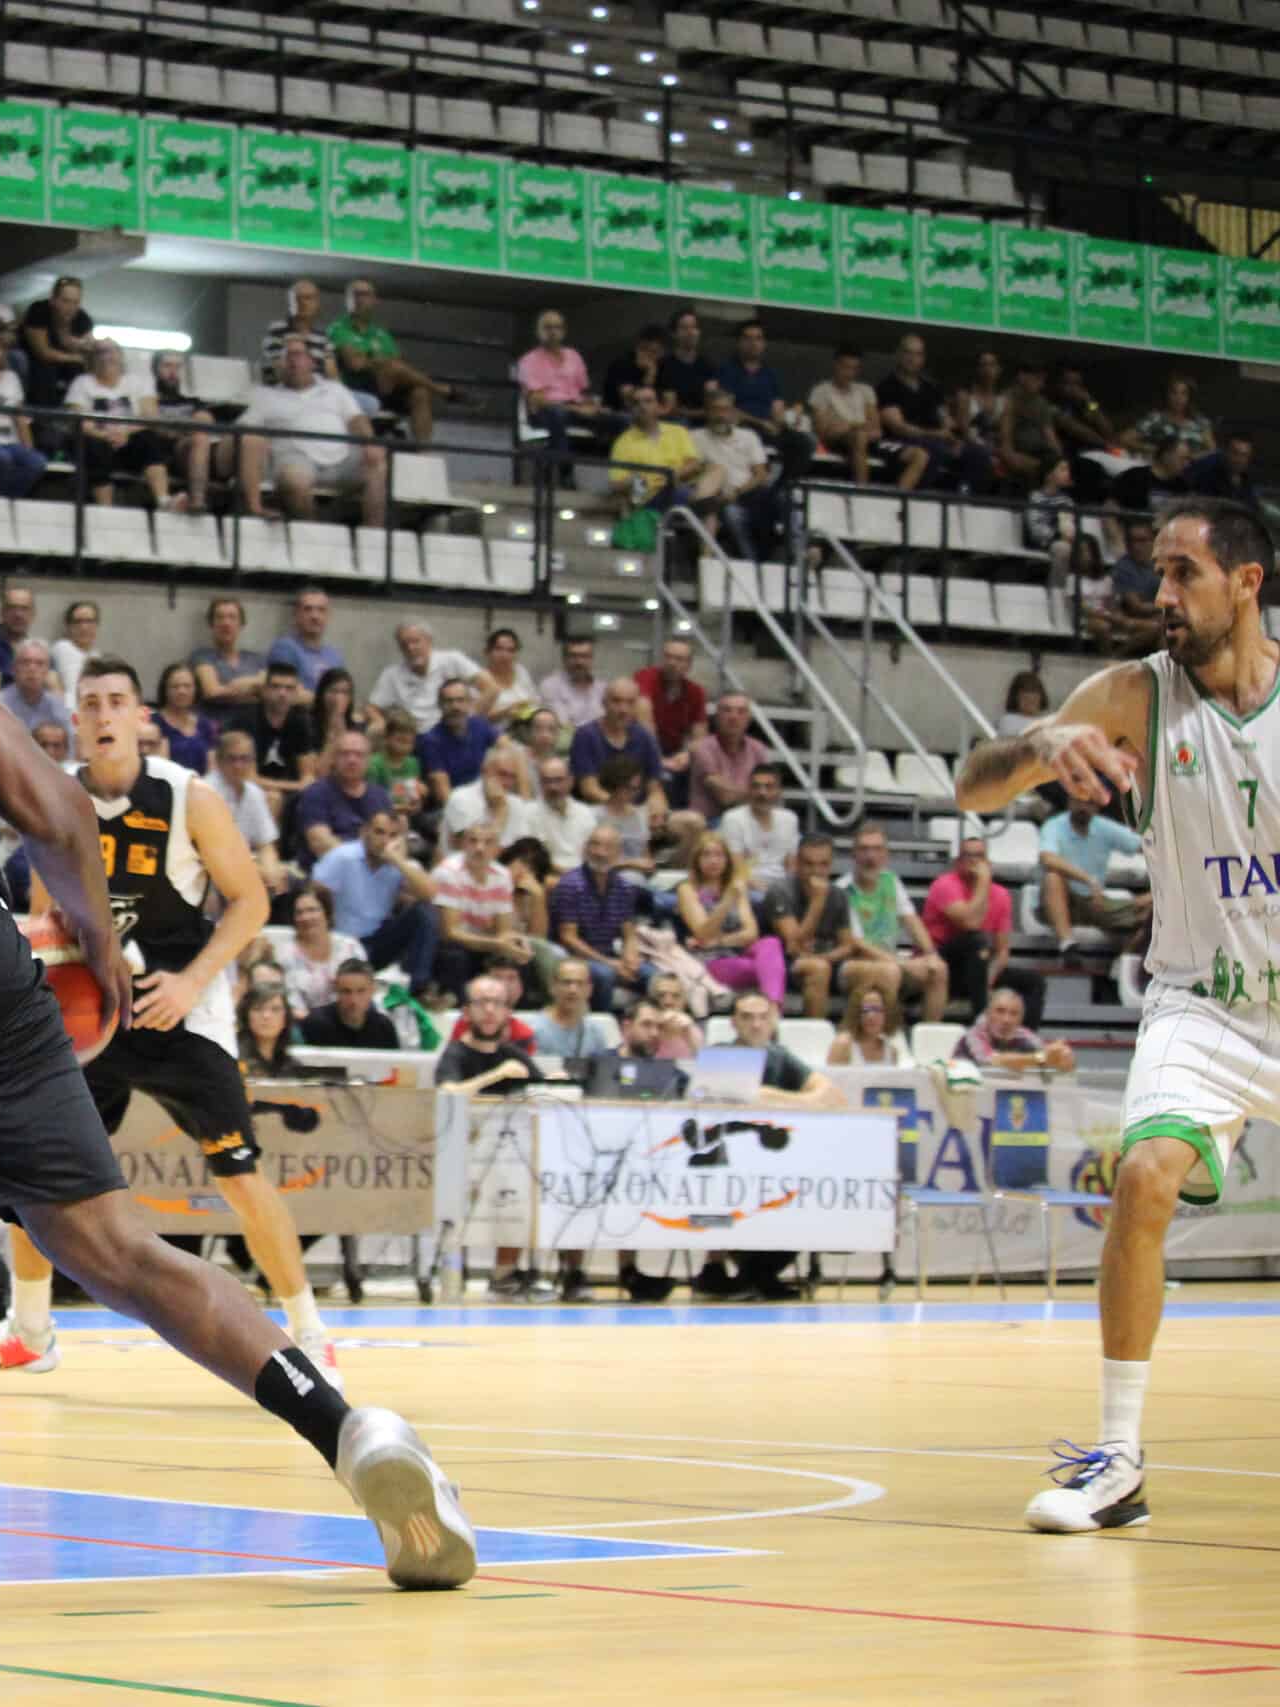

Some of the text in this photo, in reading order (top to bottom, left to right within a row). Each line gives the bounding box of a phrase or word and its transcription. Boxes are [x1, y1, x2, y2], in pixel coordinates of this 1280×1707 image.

[1238, 779, 1258, 829] 7
[540, 1170, 898, 1212] PATRONAT D'ESPORTS
